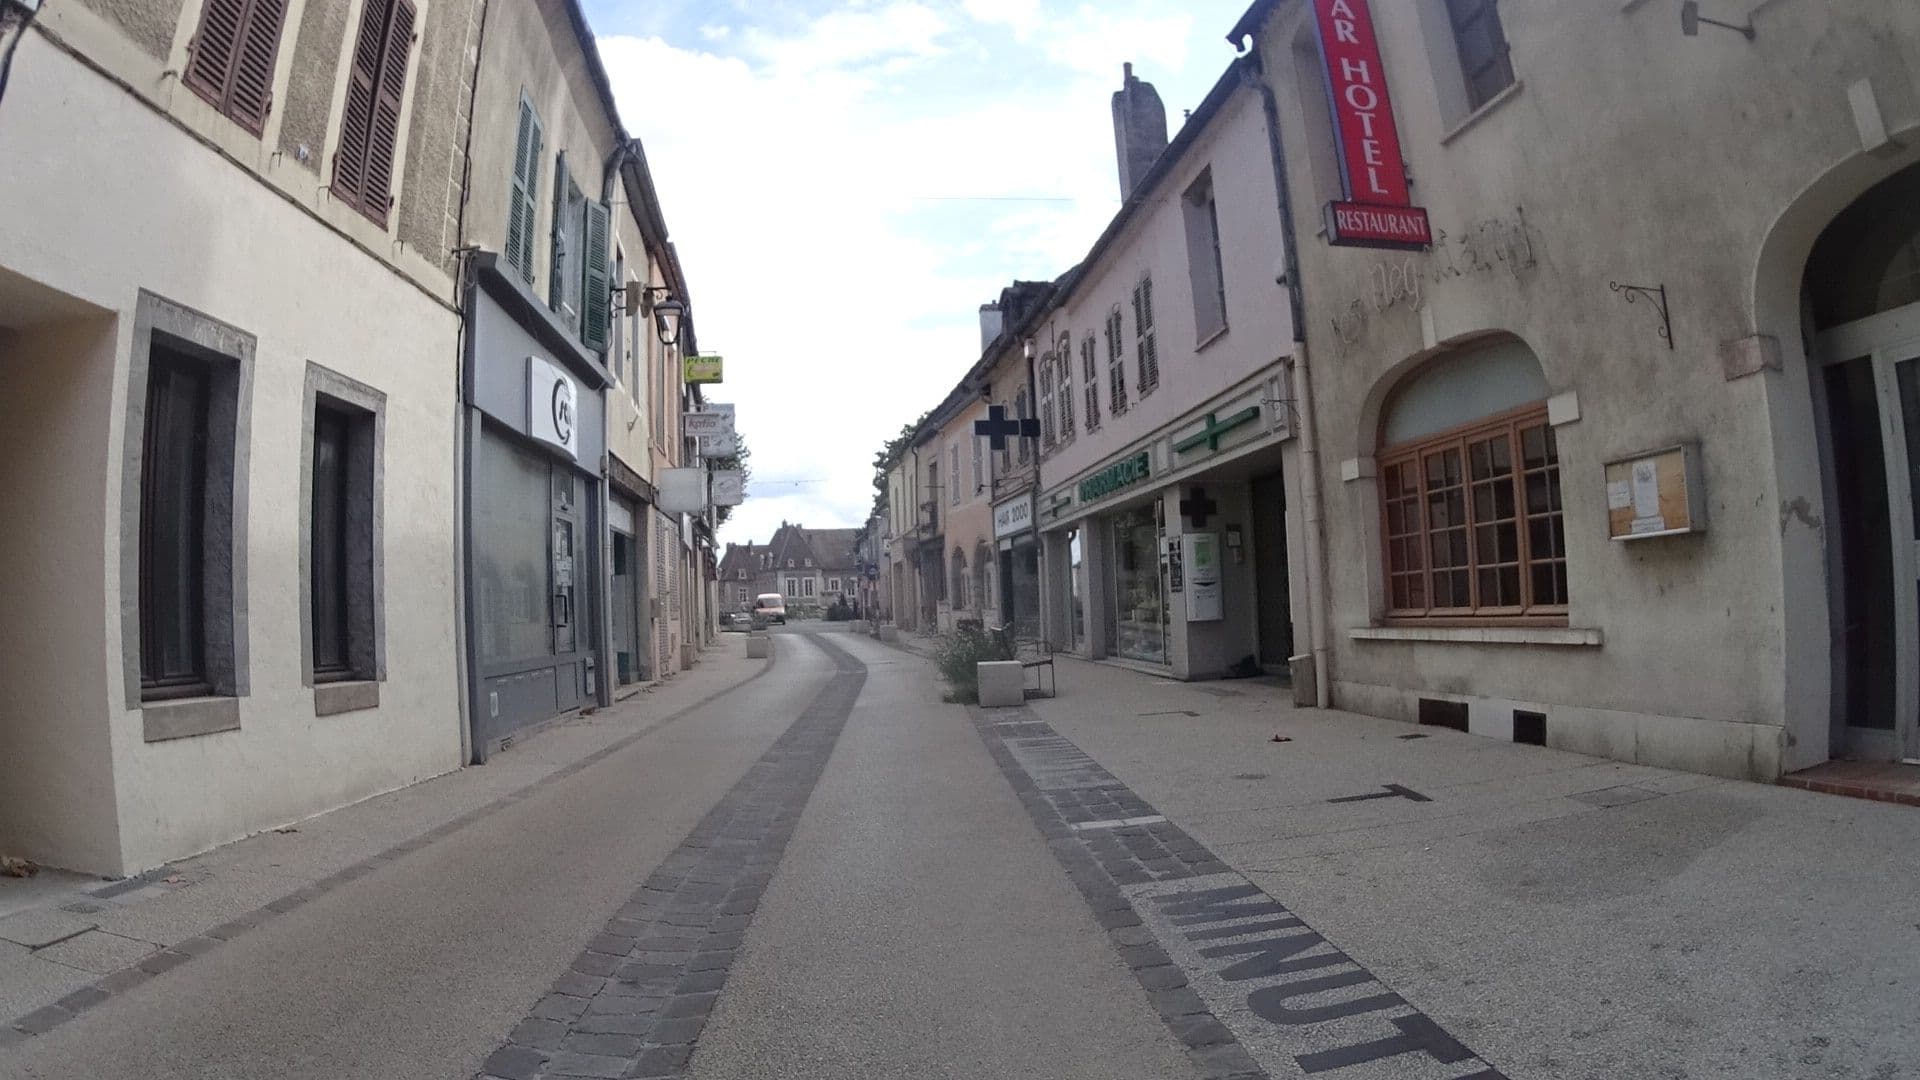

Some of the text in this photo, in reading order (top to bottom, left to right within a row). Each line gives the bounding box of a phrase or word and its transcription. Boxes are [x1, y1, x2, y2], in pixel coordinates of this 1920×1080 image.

[1340, 56, 1389, 195] HOTEL
[1336, 208, 1427, 236] RESTAURANT
[1079, 452, 1150, 503] PHARMACIE
[1012, 501, 1029, 523] 2000
[1151, 883, 1500, 1080] MINUT
